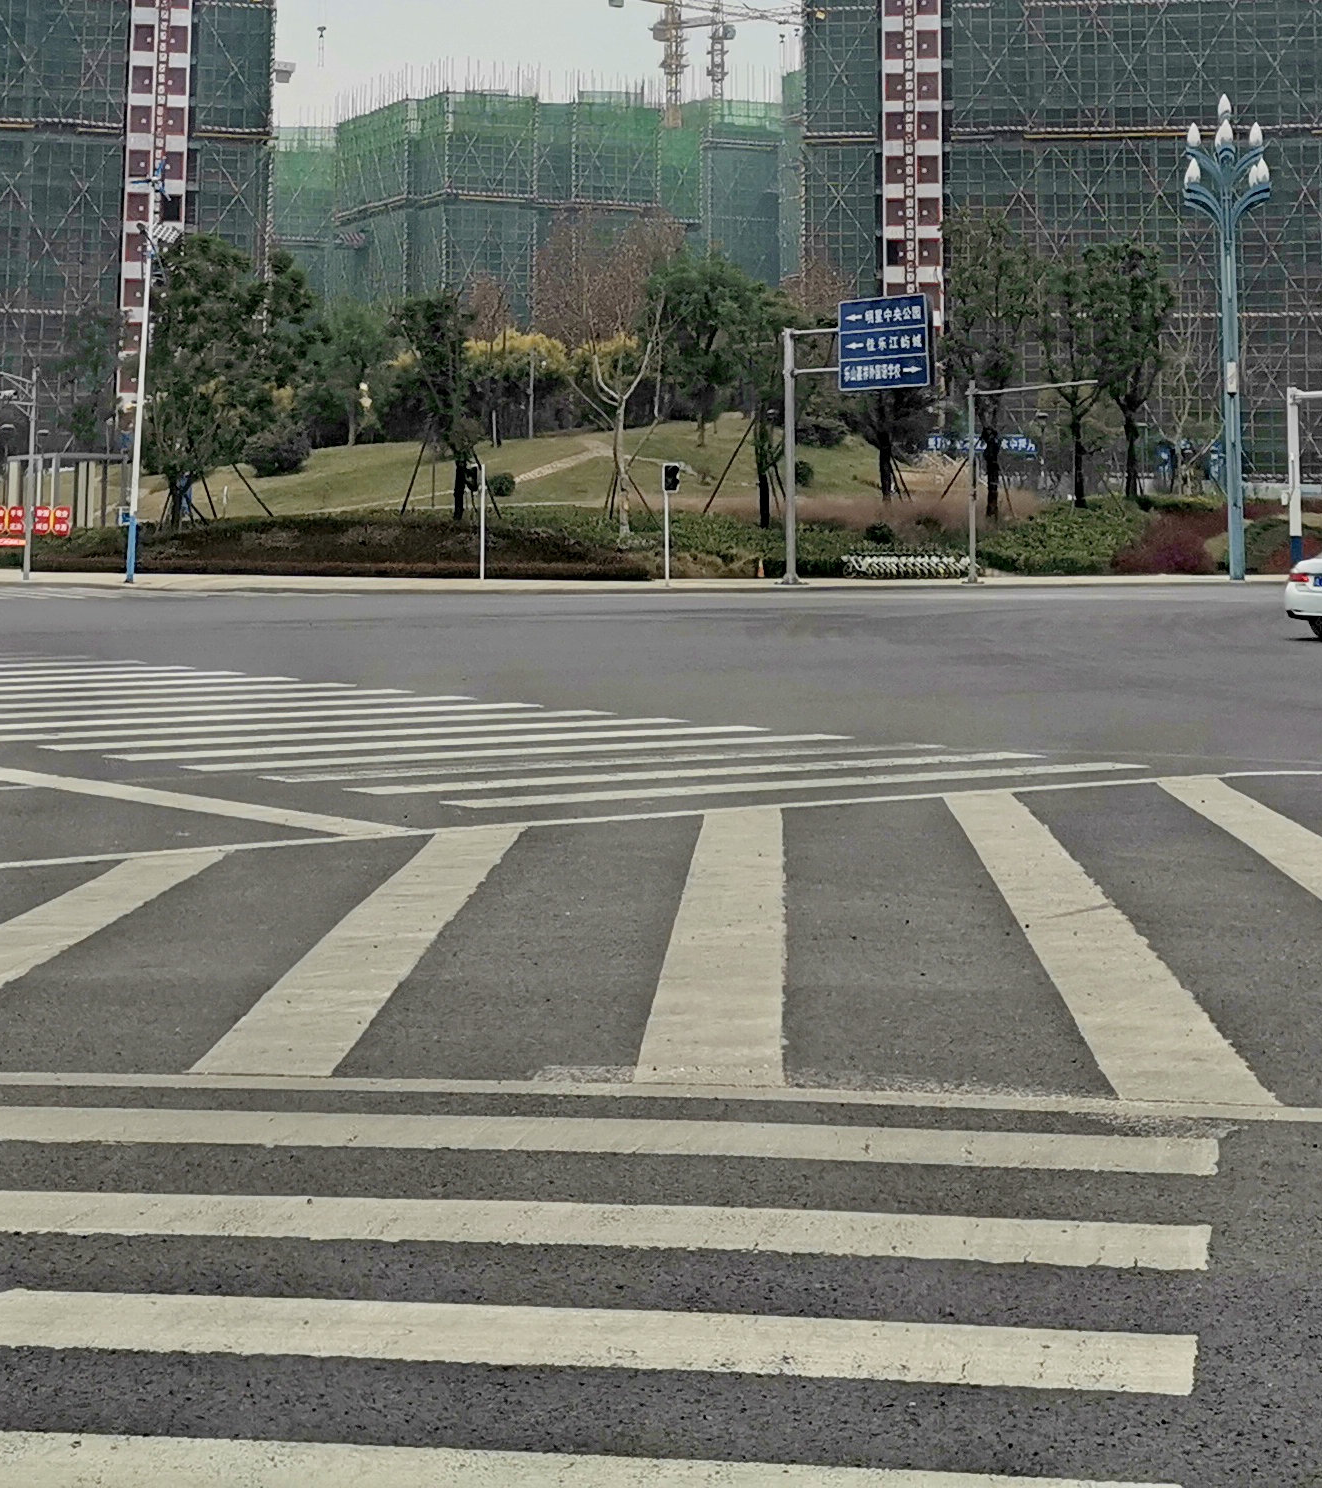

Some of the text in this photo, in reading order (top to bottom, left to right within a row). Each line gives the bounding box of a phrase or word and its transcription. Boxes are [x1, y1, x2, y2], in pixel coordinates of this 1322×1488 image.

[865, 305, 921, 324] 明星中央公园
